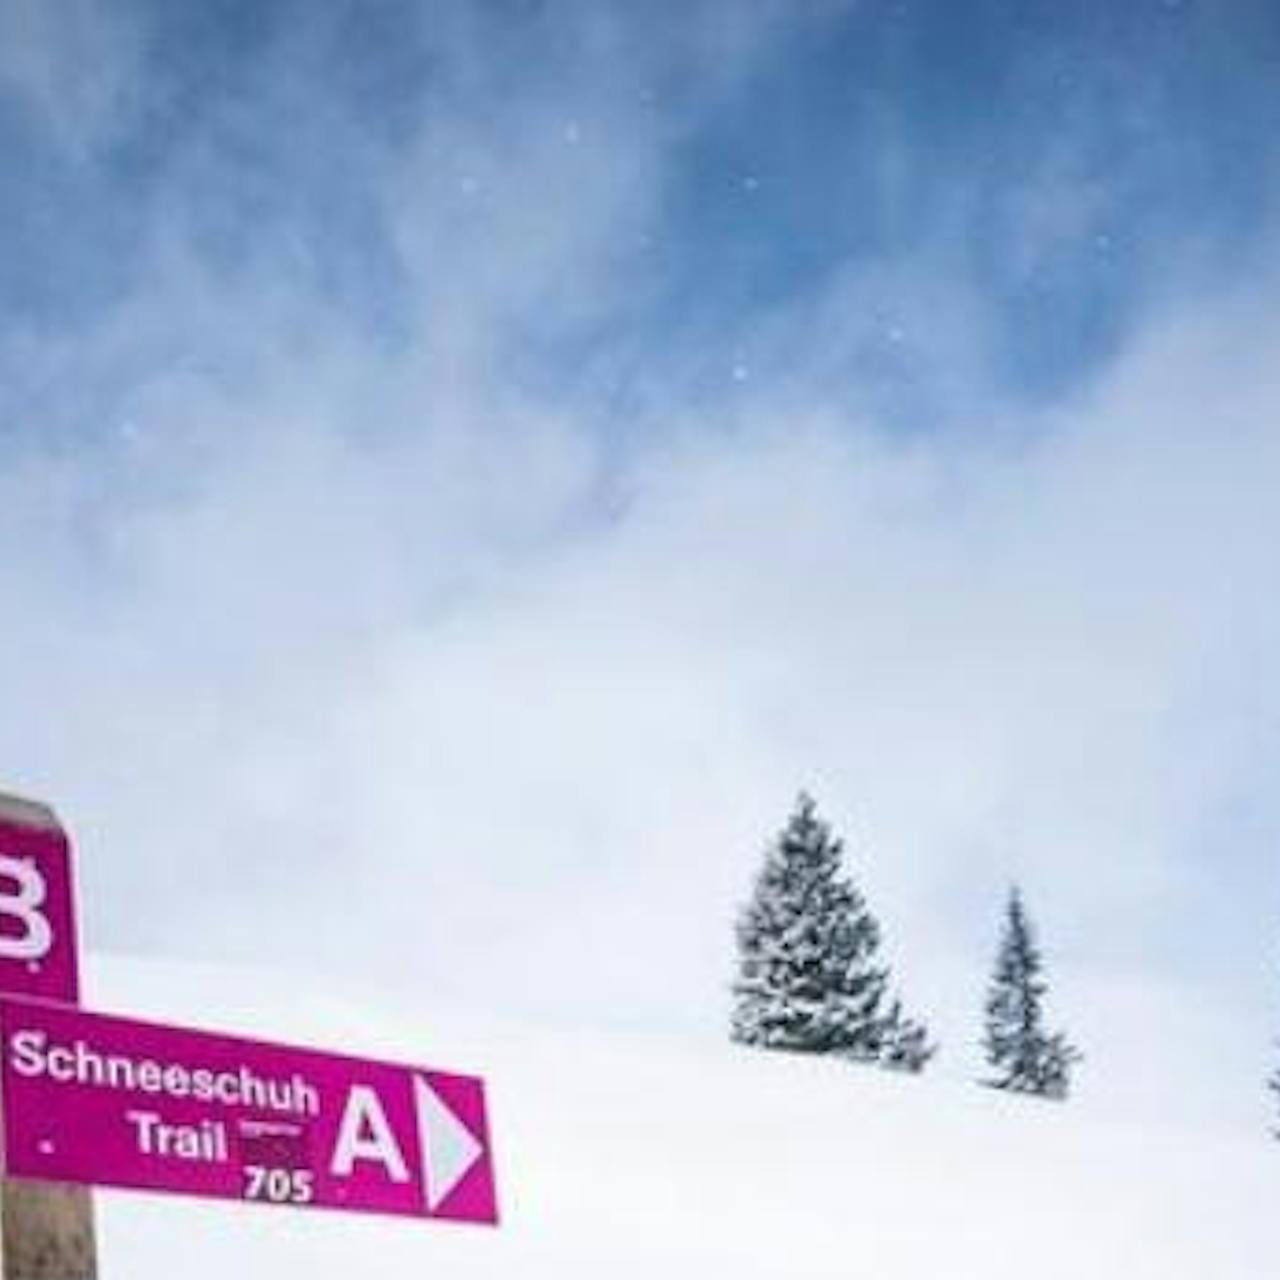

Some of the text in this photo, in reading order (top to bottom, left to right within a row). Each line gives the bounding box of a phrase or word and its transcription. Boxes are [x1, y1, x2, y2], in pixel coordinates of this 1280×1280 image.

[12, 1031, 319, 1114] Schneeschuh
[127, 1110, 228, 1161] Trail
[330, 1084, 409, 1183] A
[242, 1166, 314, 1203] 705
